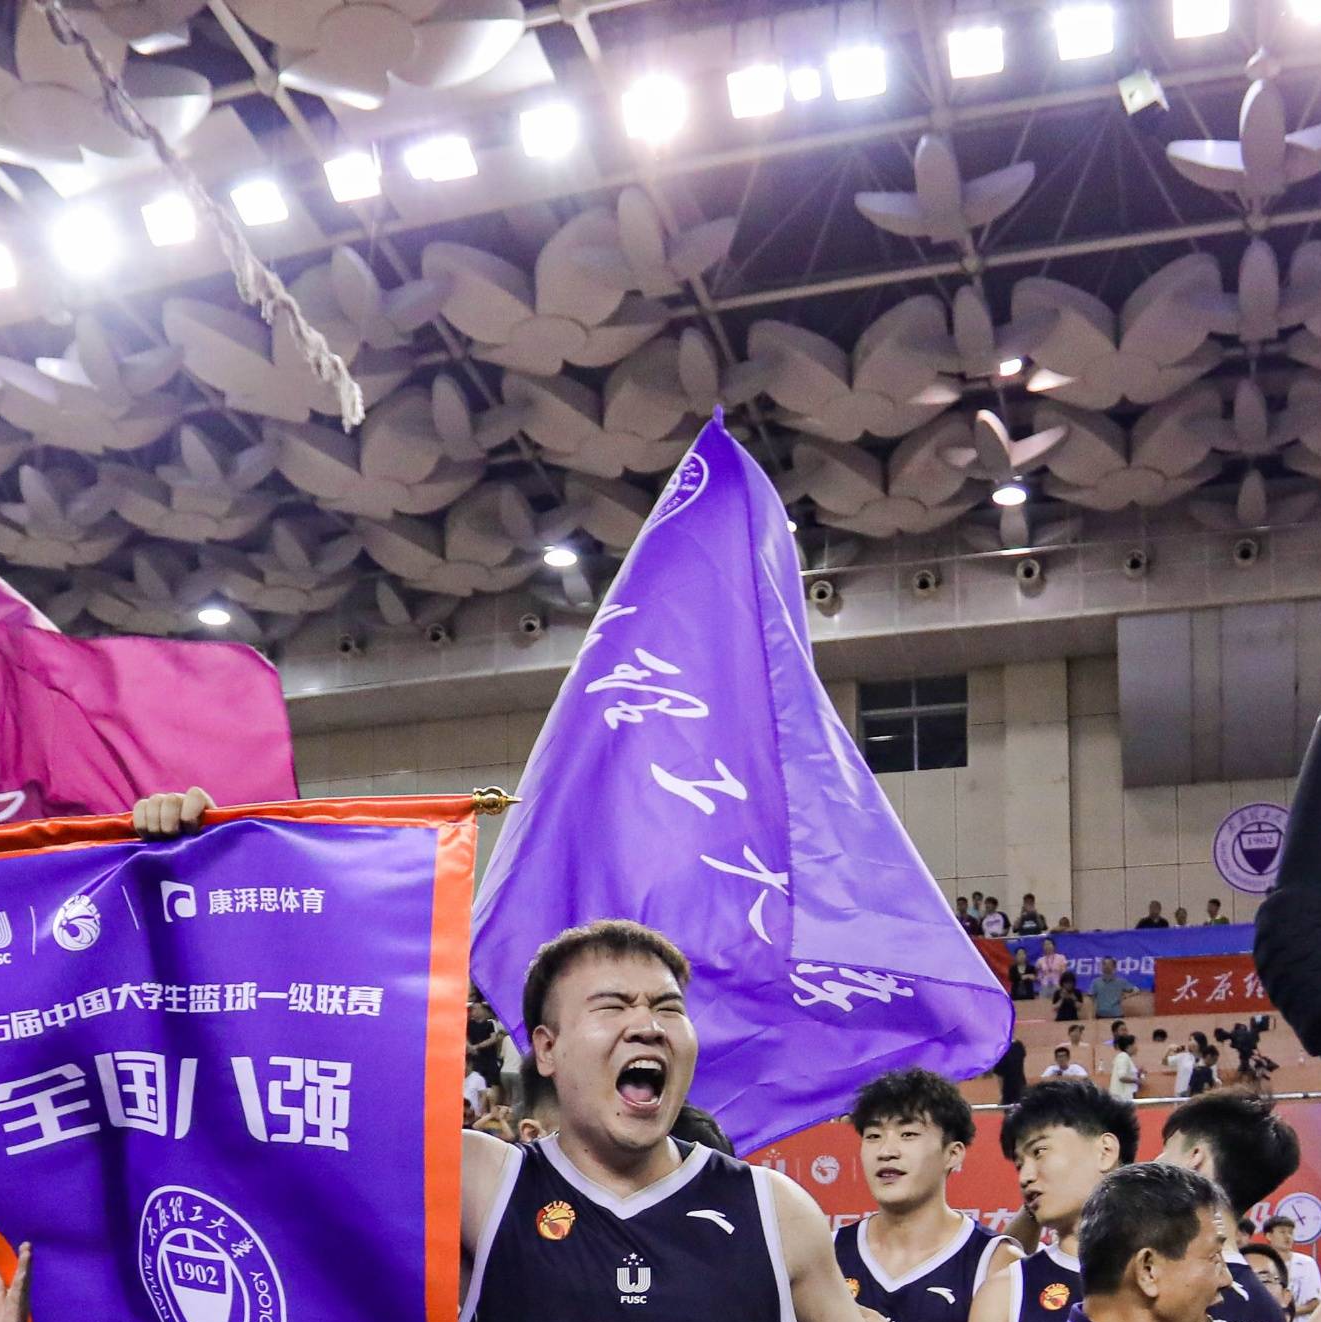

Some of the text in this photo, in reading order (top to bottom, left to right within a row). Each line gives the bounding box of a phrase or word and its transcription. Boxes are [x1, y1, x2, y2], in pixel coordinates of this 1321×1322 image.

[208, 887, 325, 915] 康湃思体育
[143, 1253, 170, 1320] TAIYUAN
[174, 1260, 219, 1286] 1902
[620, 1296, 647, 1304] FUSC
